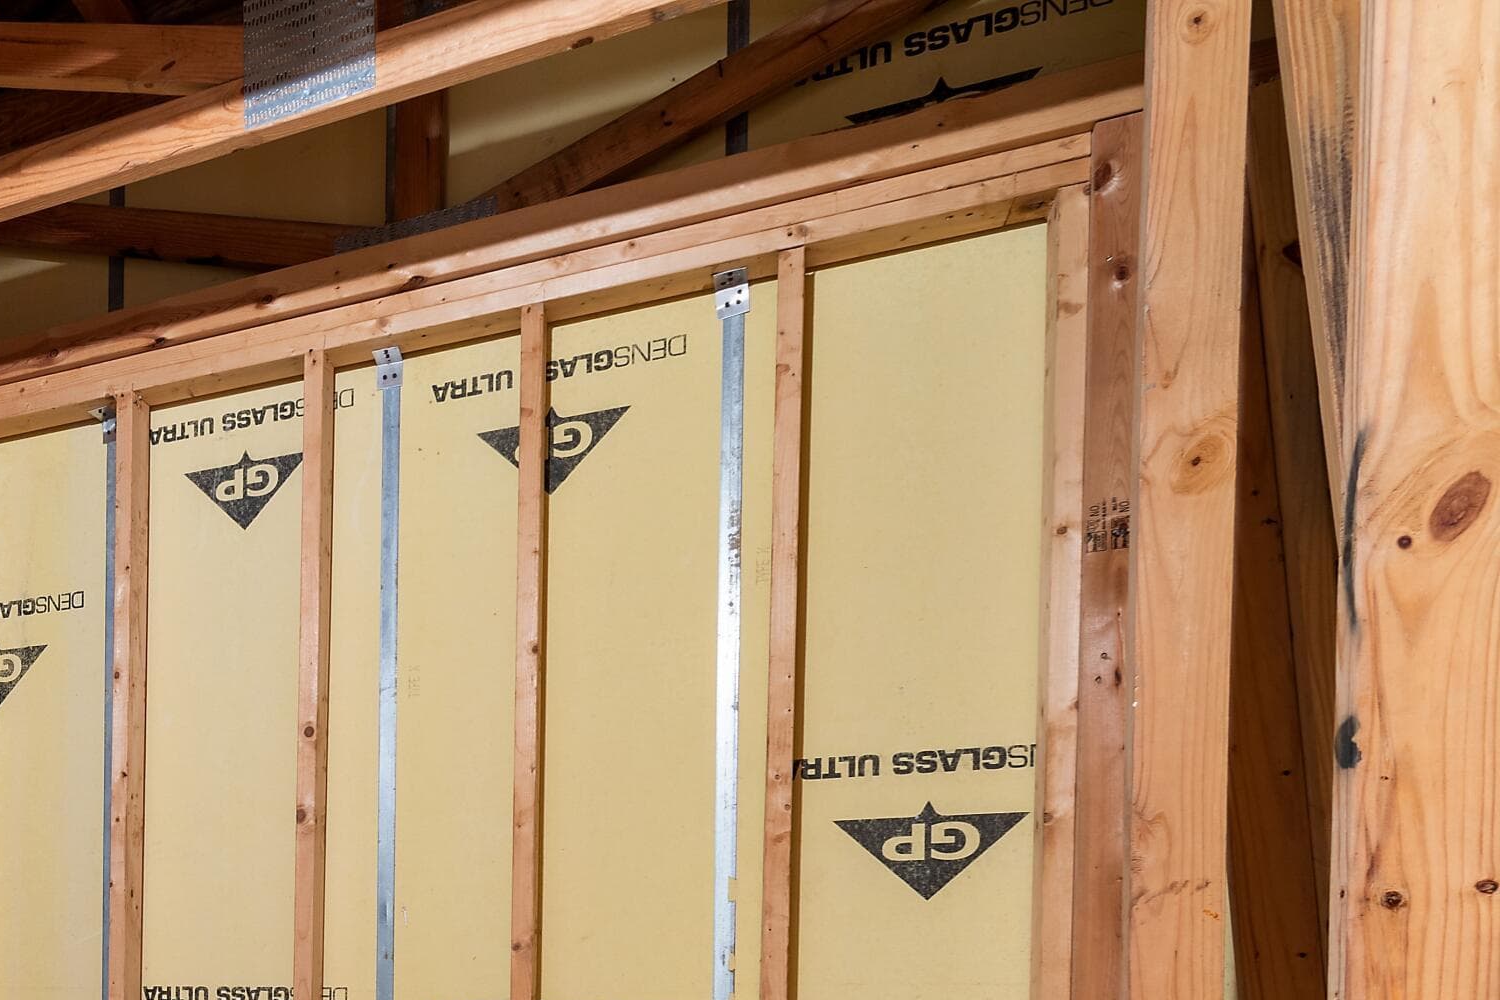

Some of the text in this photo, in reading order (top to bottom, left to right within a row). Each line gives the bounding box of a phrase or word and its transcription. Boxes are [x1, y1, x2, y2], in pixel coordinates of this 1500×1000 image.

[431, 368, 513, 403] ULTRA
[150, 416, 214, 446] ULTRA
[215, 463, 279, 502] GP
[882, 821, 981, 862] GP
